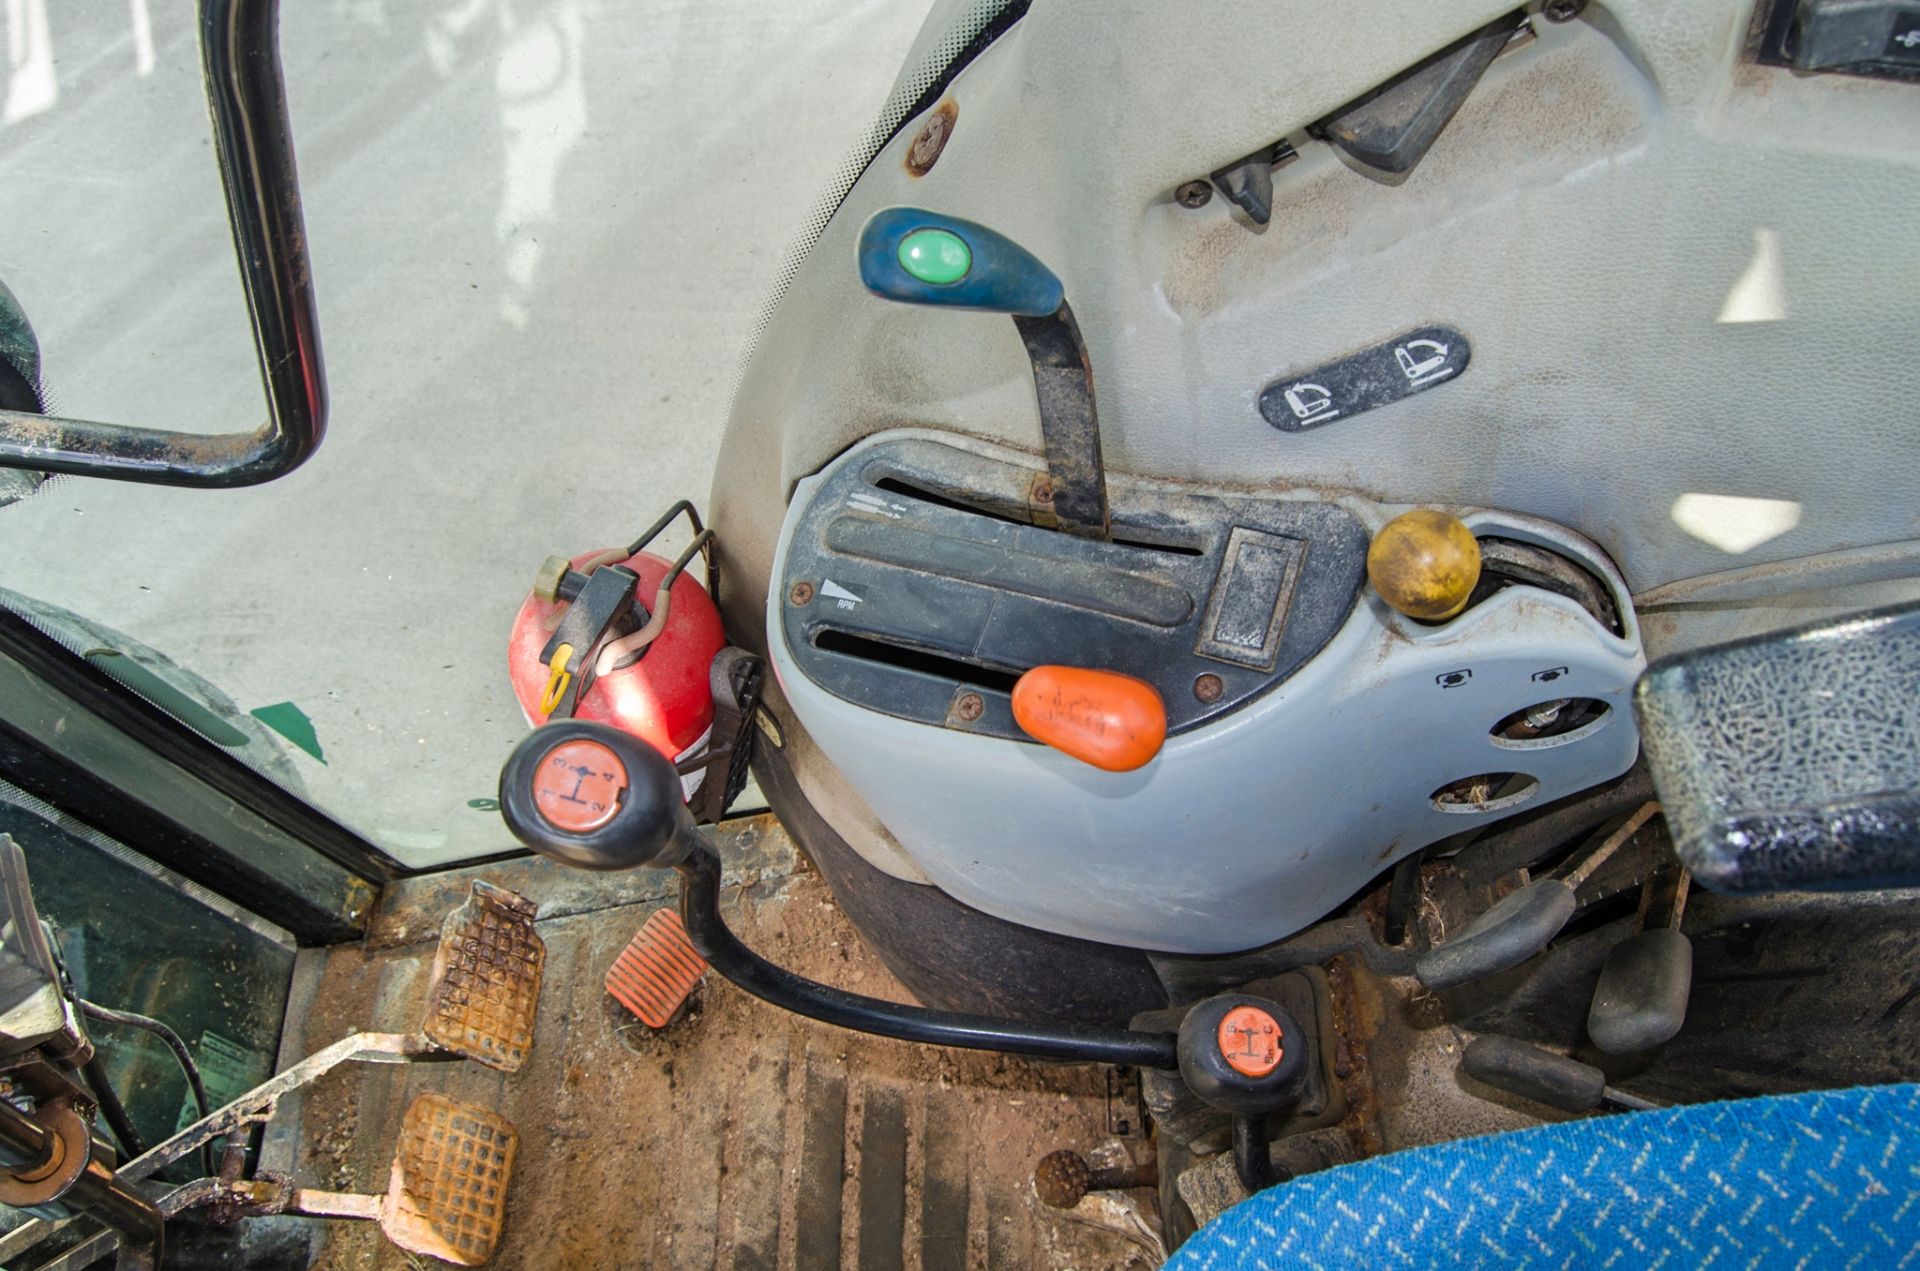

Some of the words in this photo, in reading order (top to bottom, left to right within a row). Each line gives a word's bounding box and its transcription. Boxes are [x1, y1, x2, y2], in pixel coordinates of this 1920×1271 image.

[837, 599, 856, 610] RPM
[553, 757, 566, 768] 3
[602, 771, 615, 782] 4
[592, 802, 605, 813] 2
